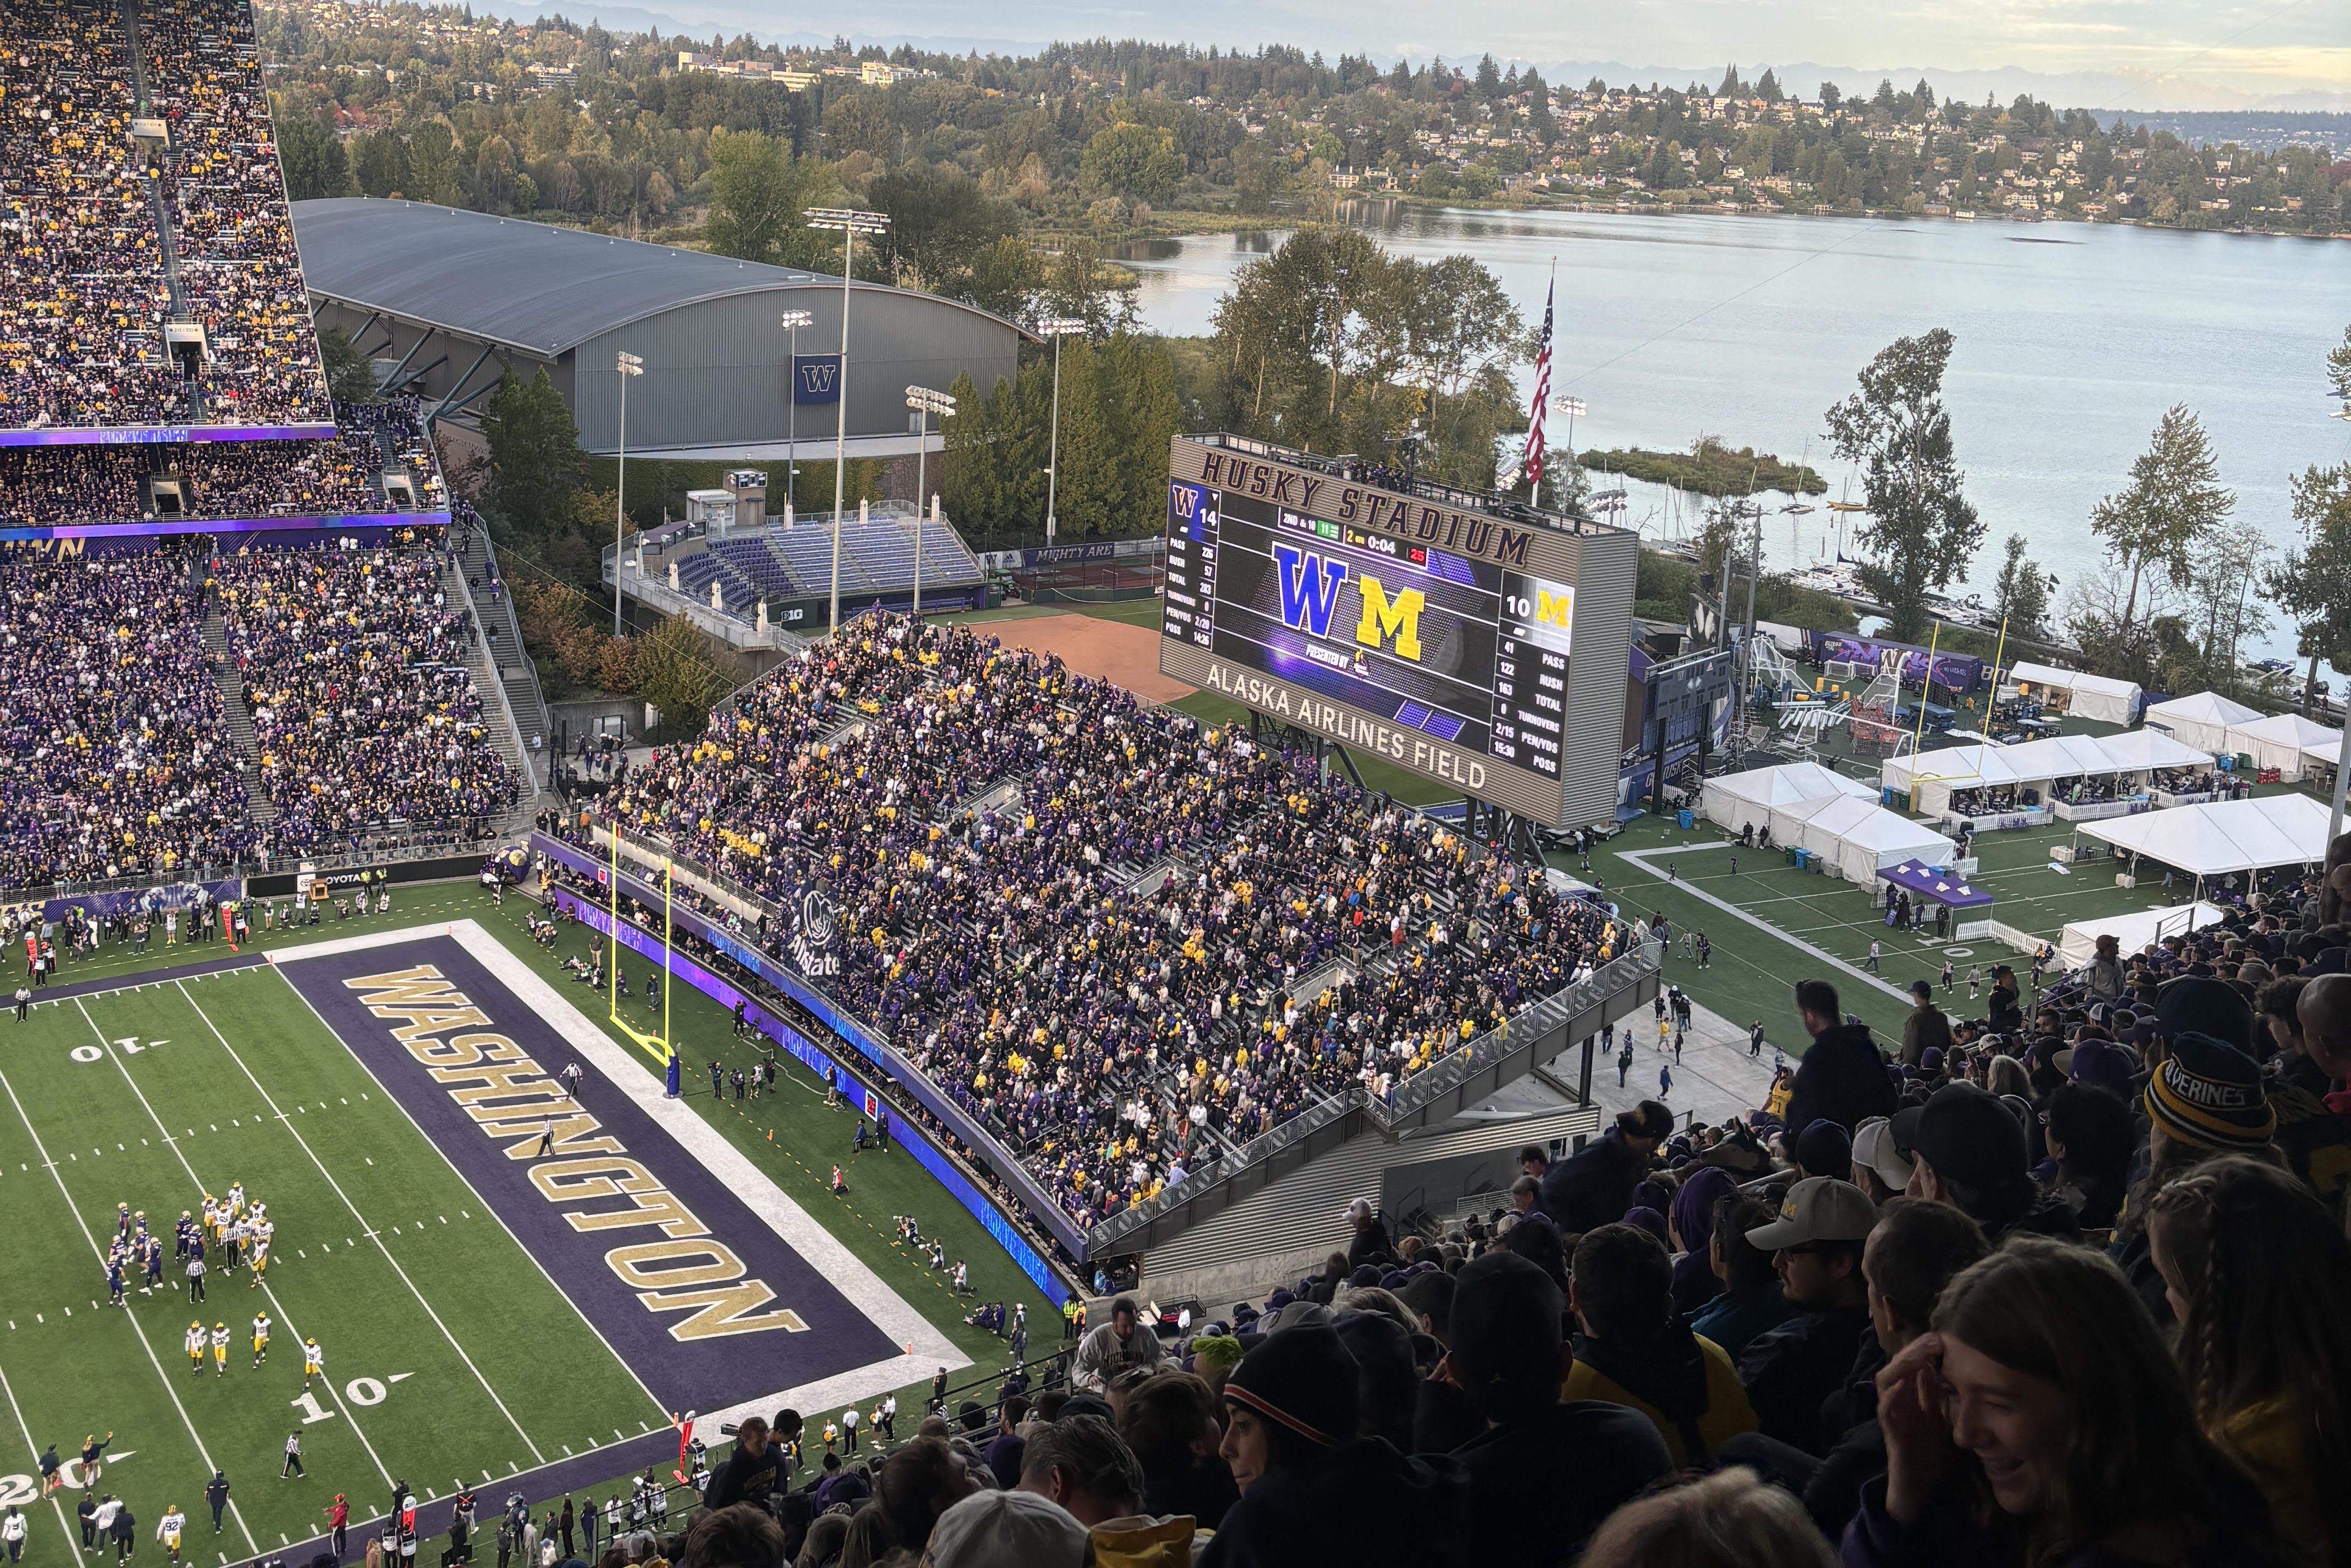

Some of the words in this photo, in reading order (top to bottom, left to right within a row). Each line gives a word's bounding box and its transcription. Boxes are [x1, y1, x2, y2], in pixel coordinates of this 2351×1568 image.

[802, 364, 836, 392] W
[1173, 485, 1198, 518] W
[1201, 452, 1322, 510] HUSKY
[1338, 487, 1535, 568] STADIUM
[1200, 508, 1217, 526] 14
[1283, 513, 1298, 527] 2ND
[1347, 530, 1353, 543] 2
[1368, 536, 1396, 554] 0:04
[1036, 547, 1084, 561] MIGHTY
[1170, 537, 1185, 551] PASS
[1202, 547, 1213, 559] 226
[1409, 548, 1425, 562] 25
[1169, 555, 1185, 568] RUSH
[1204, 566, 1212, 577] 57
[1168, 572, 1186, 586] TOTAL
[1271, 541, 1349, 639] W
[1167, 589, 1196, 607] TURNOVERS
[1506, 595, 1530, 617] 10
[1537, 590, 1571, 628] M
[1166, 606, 1191, 623] PEN/YDS
[1356, 574, 1425, 662] M
[1166, 622, 1181, 636] POSS
[1504, 642, 1514, 654] 41
[1542, 653, 1565, 670] PASS
[1500, 661, 1515, 676] 122
[1539, 674, 1563, 691] RUSH
[1535, 694, 1561, 712] TOTAL
[1207, 664, 1290, 716] ALASKA
[1297, 698, 1404, 760] AIRLINES
[1414, 739, 1487, 789] FIELD
[1517, 710, 1560, 733] TURNOVERS
[1495, 722, 1515, 739] 2/15
[1521, 732, 1558, 755] PEN/YDS
[1533, 755, 1556, 773] POSS
[325, 873, 362, 885] OYOTA
[787, 934, 841, 976] Allstate
[342, 964, 811, 1342] WASHINGTON
[165, 1521, 179, 1532] 92
